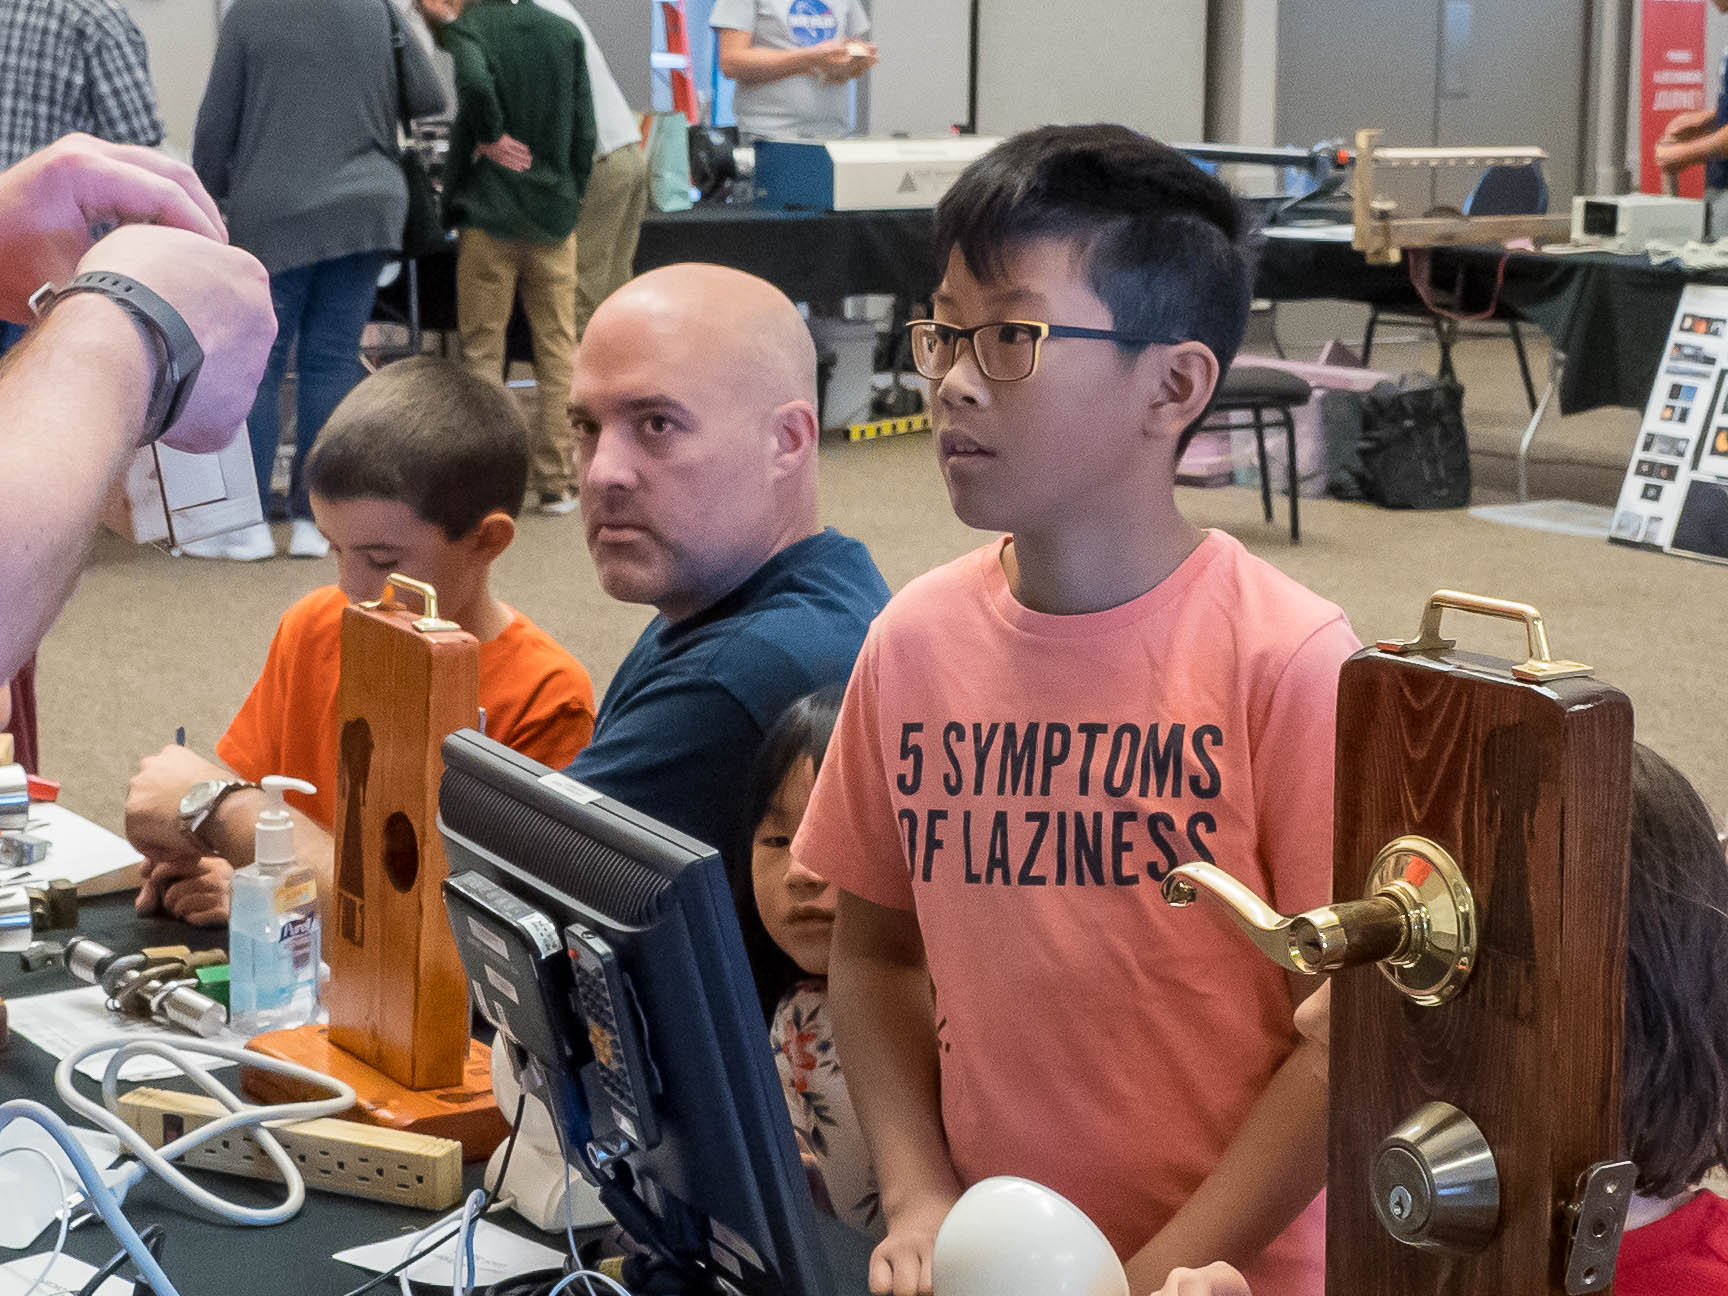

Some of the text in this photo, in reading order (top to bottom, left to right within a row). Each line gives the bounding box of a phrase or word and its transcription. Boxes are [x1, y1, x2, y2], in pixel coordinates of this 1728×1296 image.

[896, 720, 1224, 800] 5 SYMPTOMS
[898, 808, 1218, 887] OF LAZINESS
